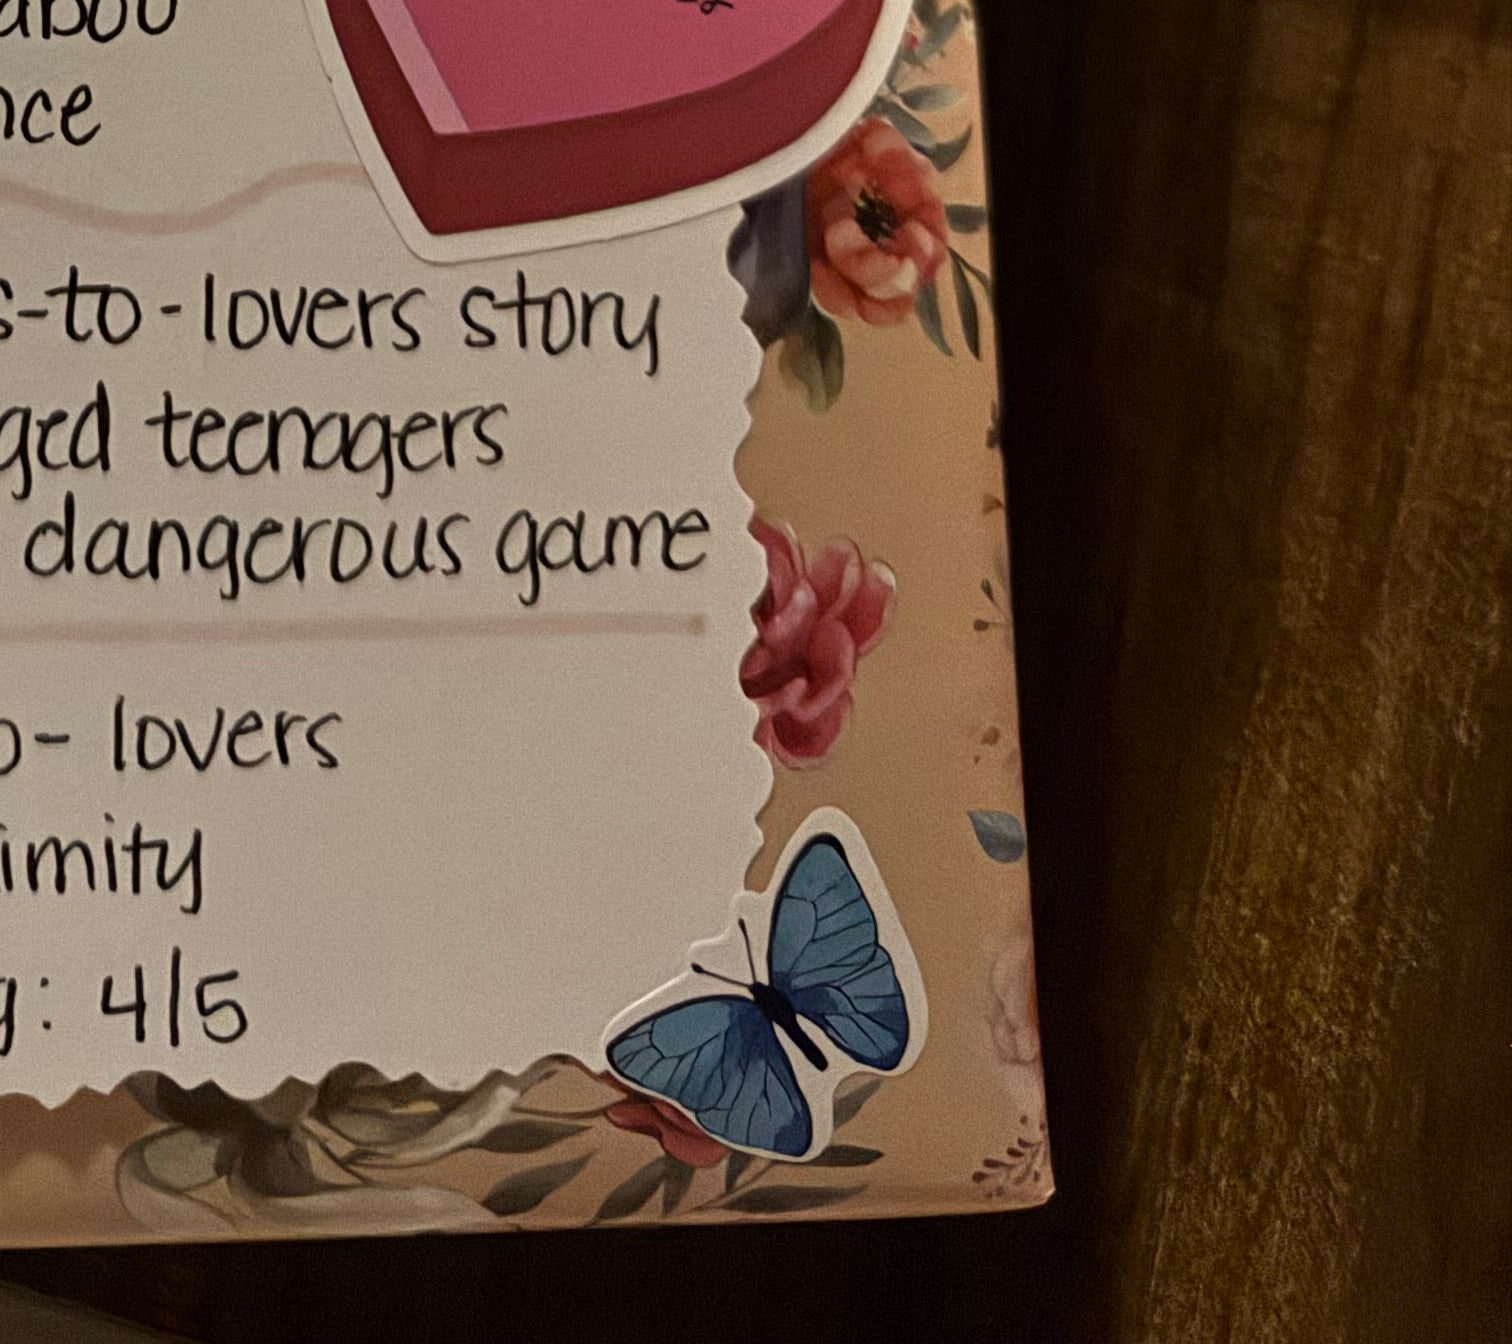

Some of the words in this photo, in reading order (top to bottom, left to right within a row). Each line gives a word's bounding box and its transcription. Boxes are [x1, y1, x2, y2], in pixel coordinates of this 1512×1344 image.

[459, 269, 661, 377] story
[144, 389, 510, 500] teenagers
[24, 490, 471, 602] dangerous
[495, 508, 711, 607] game
[100, 944, 250, 1049] 4/5
